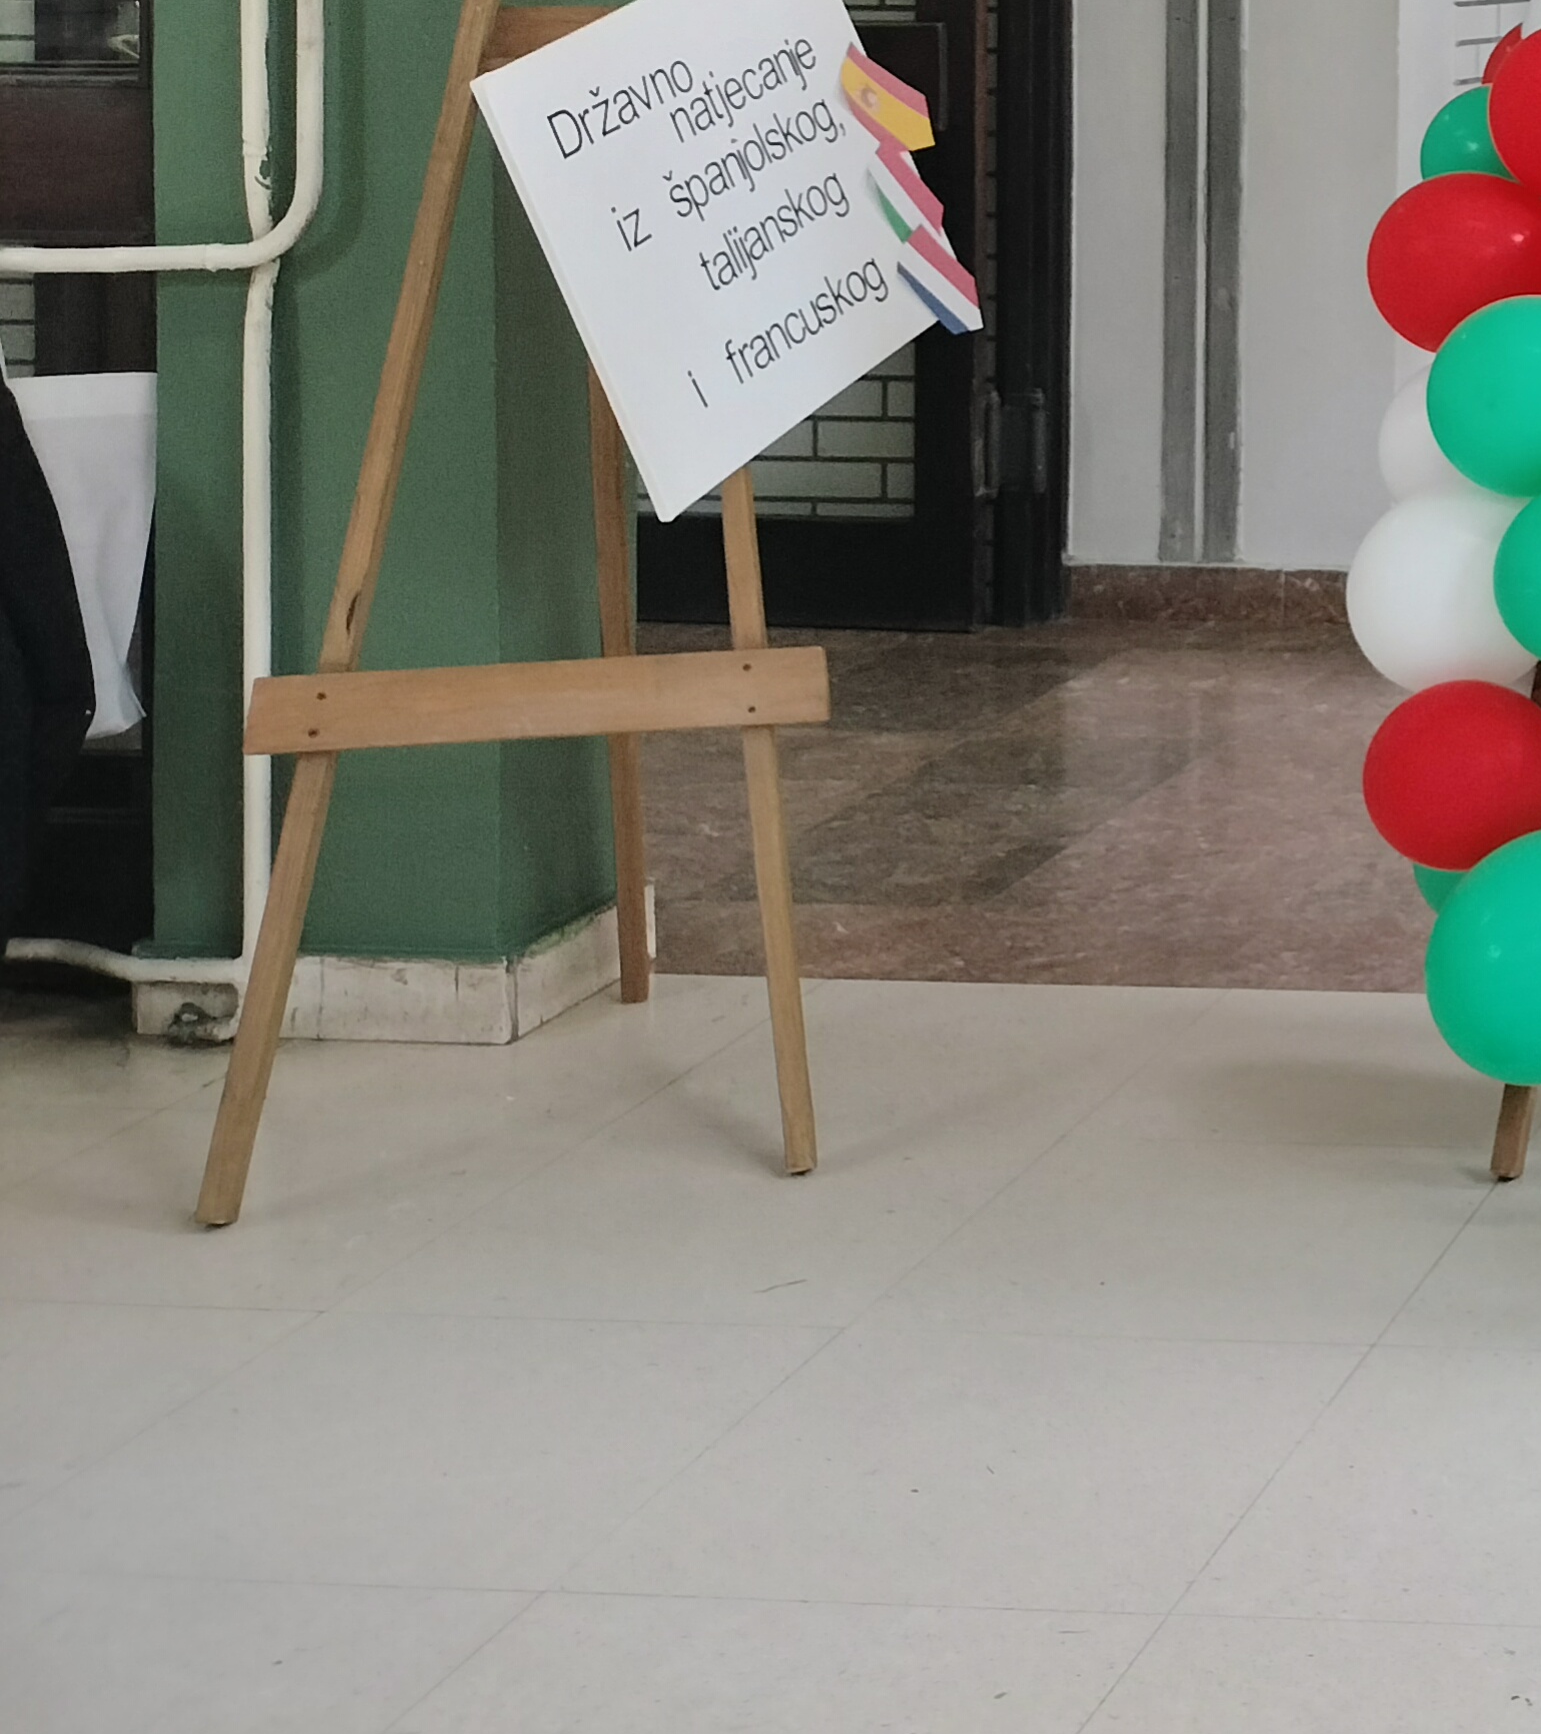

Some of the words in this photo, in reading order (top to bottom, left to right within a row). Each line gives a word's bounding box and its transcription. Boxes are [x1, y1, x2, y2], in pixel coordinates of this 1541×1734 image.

[545, 59, 696, 160] Državno
[669, 36, 818, 143] natjecanje
[610, 205, 653, 253] iz
[661, 96, 847, 223] španjolskog,
[699, 170, 852, 292] talijanskog
[687, 369, 709, 409] i
[723, 256, 890, 385] francuskog
